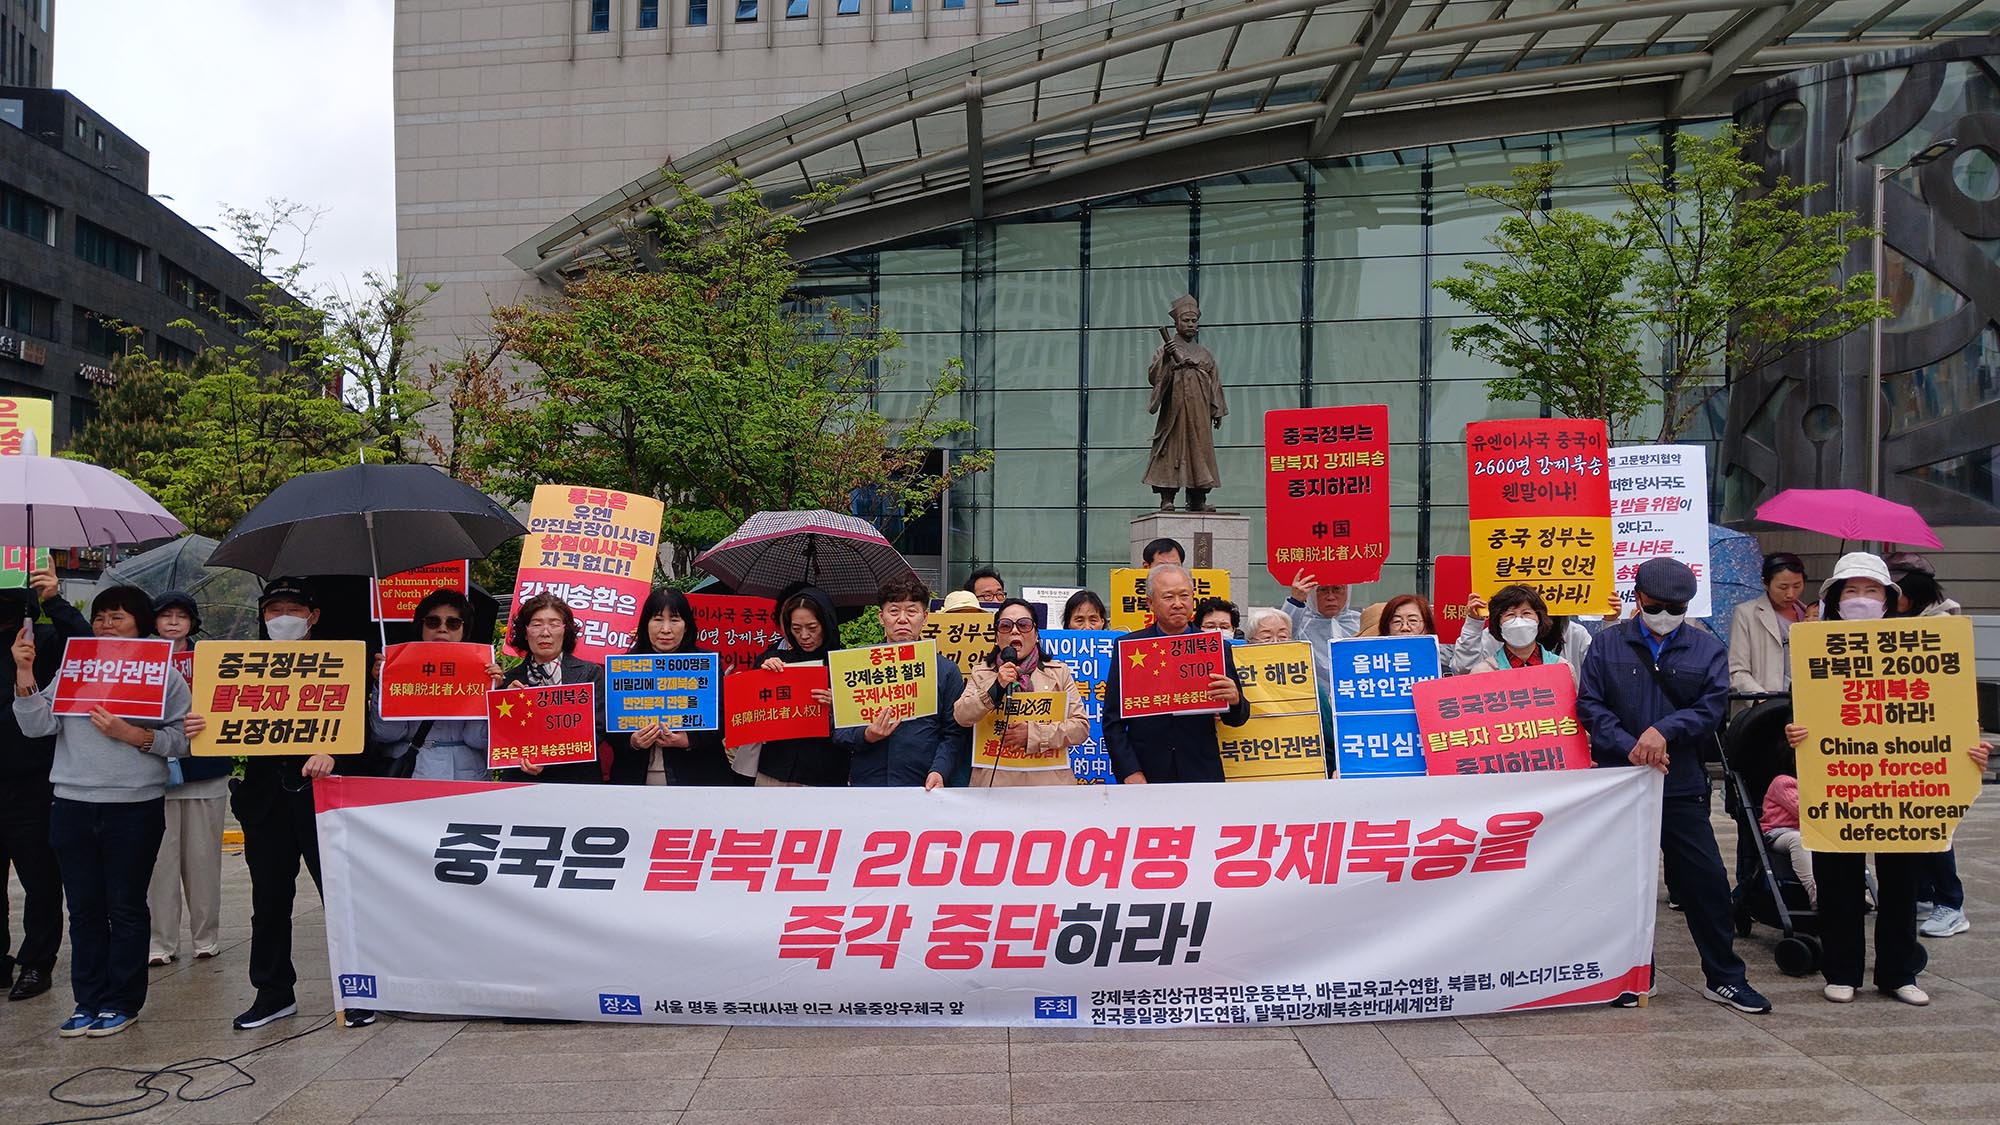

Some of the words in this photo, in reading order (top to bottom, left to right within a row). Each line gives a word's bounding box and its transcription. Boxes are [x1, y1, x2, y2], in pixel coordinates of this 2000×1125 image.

[1283, 424, 1374, 446] 중국정부는
[1471, 431, 1550, 453] 유엔이사국
[1555, 430, 1602, 450] 중국이
[1270, 453, 1319, 472] 탈북자
[1323, 450, 1385, 470] 강제북송
[1474, 456, 1531, 477] 2600명
[1536, 454, 1603, 477] 강제북송
[1619, 453, 1682, 466] 고문방지협약
[1287, 475, 1371, 498] 중지하라!
[1502, 482, 1577, 503] 웬말이냐!
[1609, 477, 1634, 491] 떠한
[1635, 476, 1686, 490] 당사국도
[567, 487, 628, 511] 중국은
[1620, 497, 1649, 514] 받을
[1651, 495, 1692, 512] 위험이
[573, 505, 613, 523] 유엔
[530, 518, 656, 546] 안전보장이사회
[1487, 528, 1532, 550] 중국
[1537, 527, 1596, 548] 정부는
[1612, 541, 1628, 557] 른
[540, 551, 631, 576] 자격없다!
[1495, 555, 1554, 578] 탈북민
[1561, 555, 1597, 577] 인권
[395, 577, 429, 587] human
[431, 577, 459, 588] rights
[382, 590, 394, 599] of
[394, 590, 421, 598] North
[918, 623, 942, 639] 국
[947, 623, 996, 643] 정부는
[1826, 632, 1869, 655] 중국
[1877, 630, 1941, 654] 정부는
[869, 647, 896, 666] 중국
[1041, 637, 1115, 658] N이사국
[1170, 636, 1219, 657] 강제북송
[62, 658, 167, 686] 북한인권법
[218, 652, 344, 679] 중국정부는
[655, 659, 665, 671] 약
[668, 658, 710, 671] 600명을
[1179, 661, 1215, 679] STOP
[1237, 664, 1258, 688] 한
[1264, 660, 1309, 685] 해방
[1352, 652, 1412, 674] 올바른
[1808, 655, 1873, 679] 탈북민
[1881, 652, 1960, 676] 2600명
[613, 678, 654, 691] 비밀리에
[657, 676, 708, 690] 강제북송한
[844, 665, 898, 688] 강제송환
[901, 662, 926, 681] 철회
[537, 688, 590, 708] 강제북송
[852, 682, 918, 706] 국제사회에
[1337, 675, 1435, 699] 북한인권
[1842, 678, 1930, 702] 강제북송
[210, 684, 290, 713] 탈북자
[297, 684, 350, 712] 인권
[1124, 695, 1151, 710] 중국은
[1153, 693, 1171, 707] 즉각
[1174, 690, 1216, 705] 북송중단
[1438, 687, 1556, 720] 중국정부는
[545, 713, 582, 730] STOP
[860, 702, 915, 724] 약하라!
[1840, 702, 1935, 726] 중지하라!
[216, 718, 341, 745] 보장하라!!
[1427, 725, 1490, 754] 탈북자
[1494, 716, 1578, 743] 강제북송
[491, 746, 518, 761] 중국은
[521, 745, 539, 759] 즉각
[540, 742, 593, 757] 북송중단하라
[1220, 735, 1322, 762] 북한인권법
[1820, 737, 1878, 755] China
[1884, 735, 1952, 754] should
[1827, 760, 1873, 781] stop
[1879, 757, 1947, 776] forced
[1826, 779, 1950, 802] repatriation
[1807, 801, 1829, 819] of
[1835, 801, 1893, 819] North
[1899, 800, 1970, 819] Korean
[1840, 823, 1948, 841] defectors!
[433, 823, 631, 891] 중국은
[642, 828, 843, 892] 탈북민
[852, 825, 1197, 891] 2600여명
[1213, 811, 1545, 888] 강제북송을
[778, 904, 913, 970] 즉각
[924, 901, 1213, 970] 중단하라!
[342, 977, 373, 996] 일시
[1090, 984, 1312, 1006] 강제북송진상규명국민운동본부,
[1315, 977, 1443, 1000] 바른교육교수연합,
[1447, 972, 1496, 991] 북클럽,
[1500, 961, 1604, 988] 에스더기도운동,
[603, 998, 637, 1013] 장소
[654, 1000, 684, 1014] 서울
[687, 1001, 718, 1015] 명동
[722, 1001, 799, 1015] 중국대사관
[802, 1002, 833, 1015] 인근
[838, 1001, 945, 1016] 서울중앙우체국
[949, 1001, 965, 1016] 앞
[1038, 999, 1073, 1017] 주최
[1090, 1005, 1250, 1026] 전국통일광장기도연합,
[1255, 995, 1455, 1022] 탈북민강제북송반대세계연합
